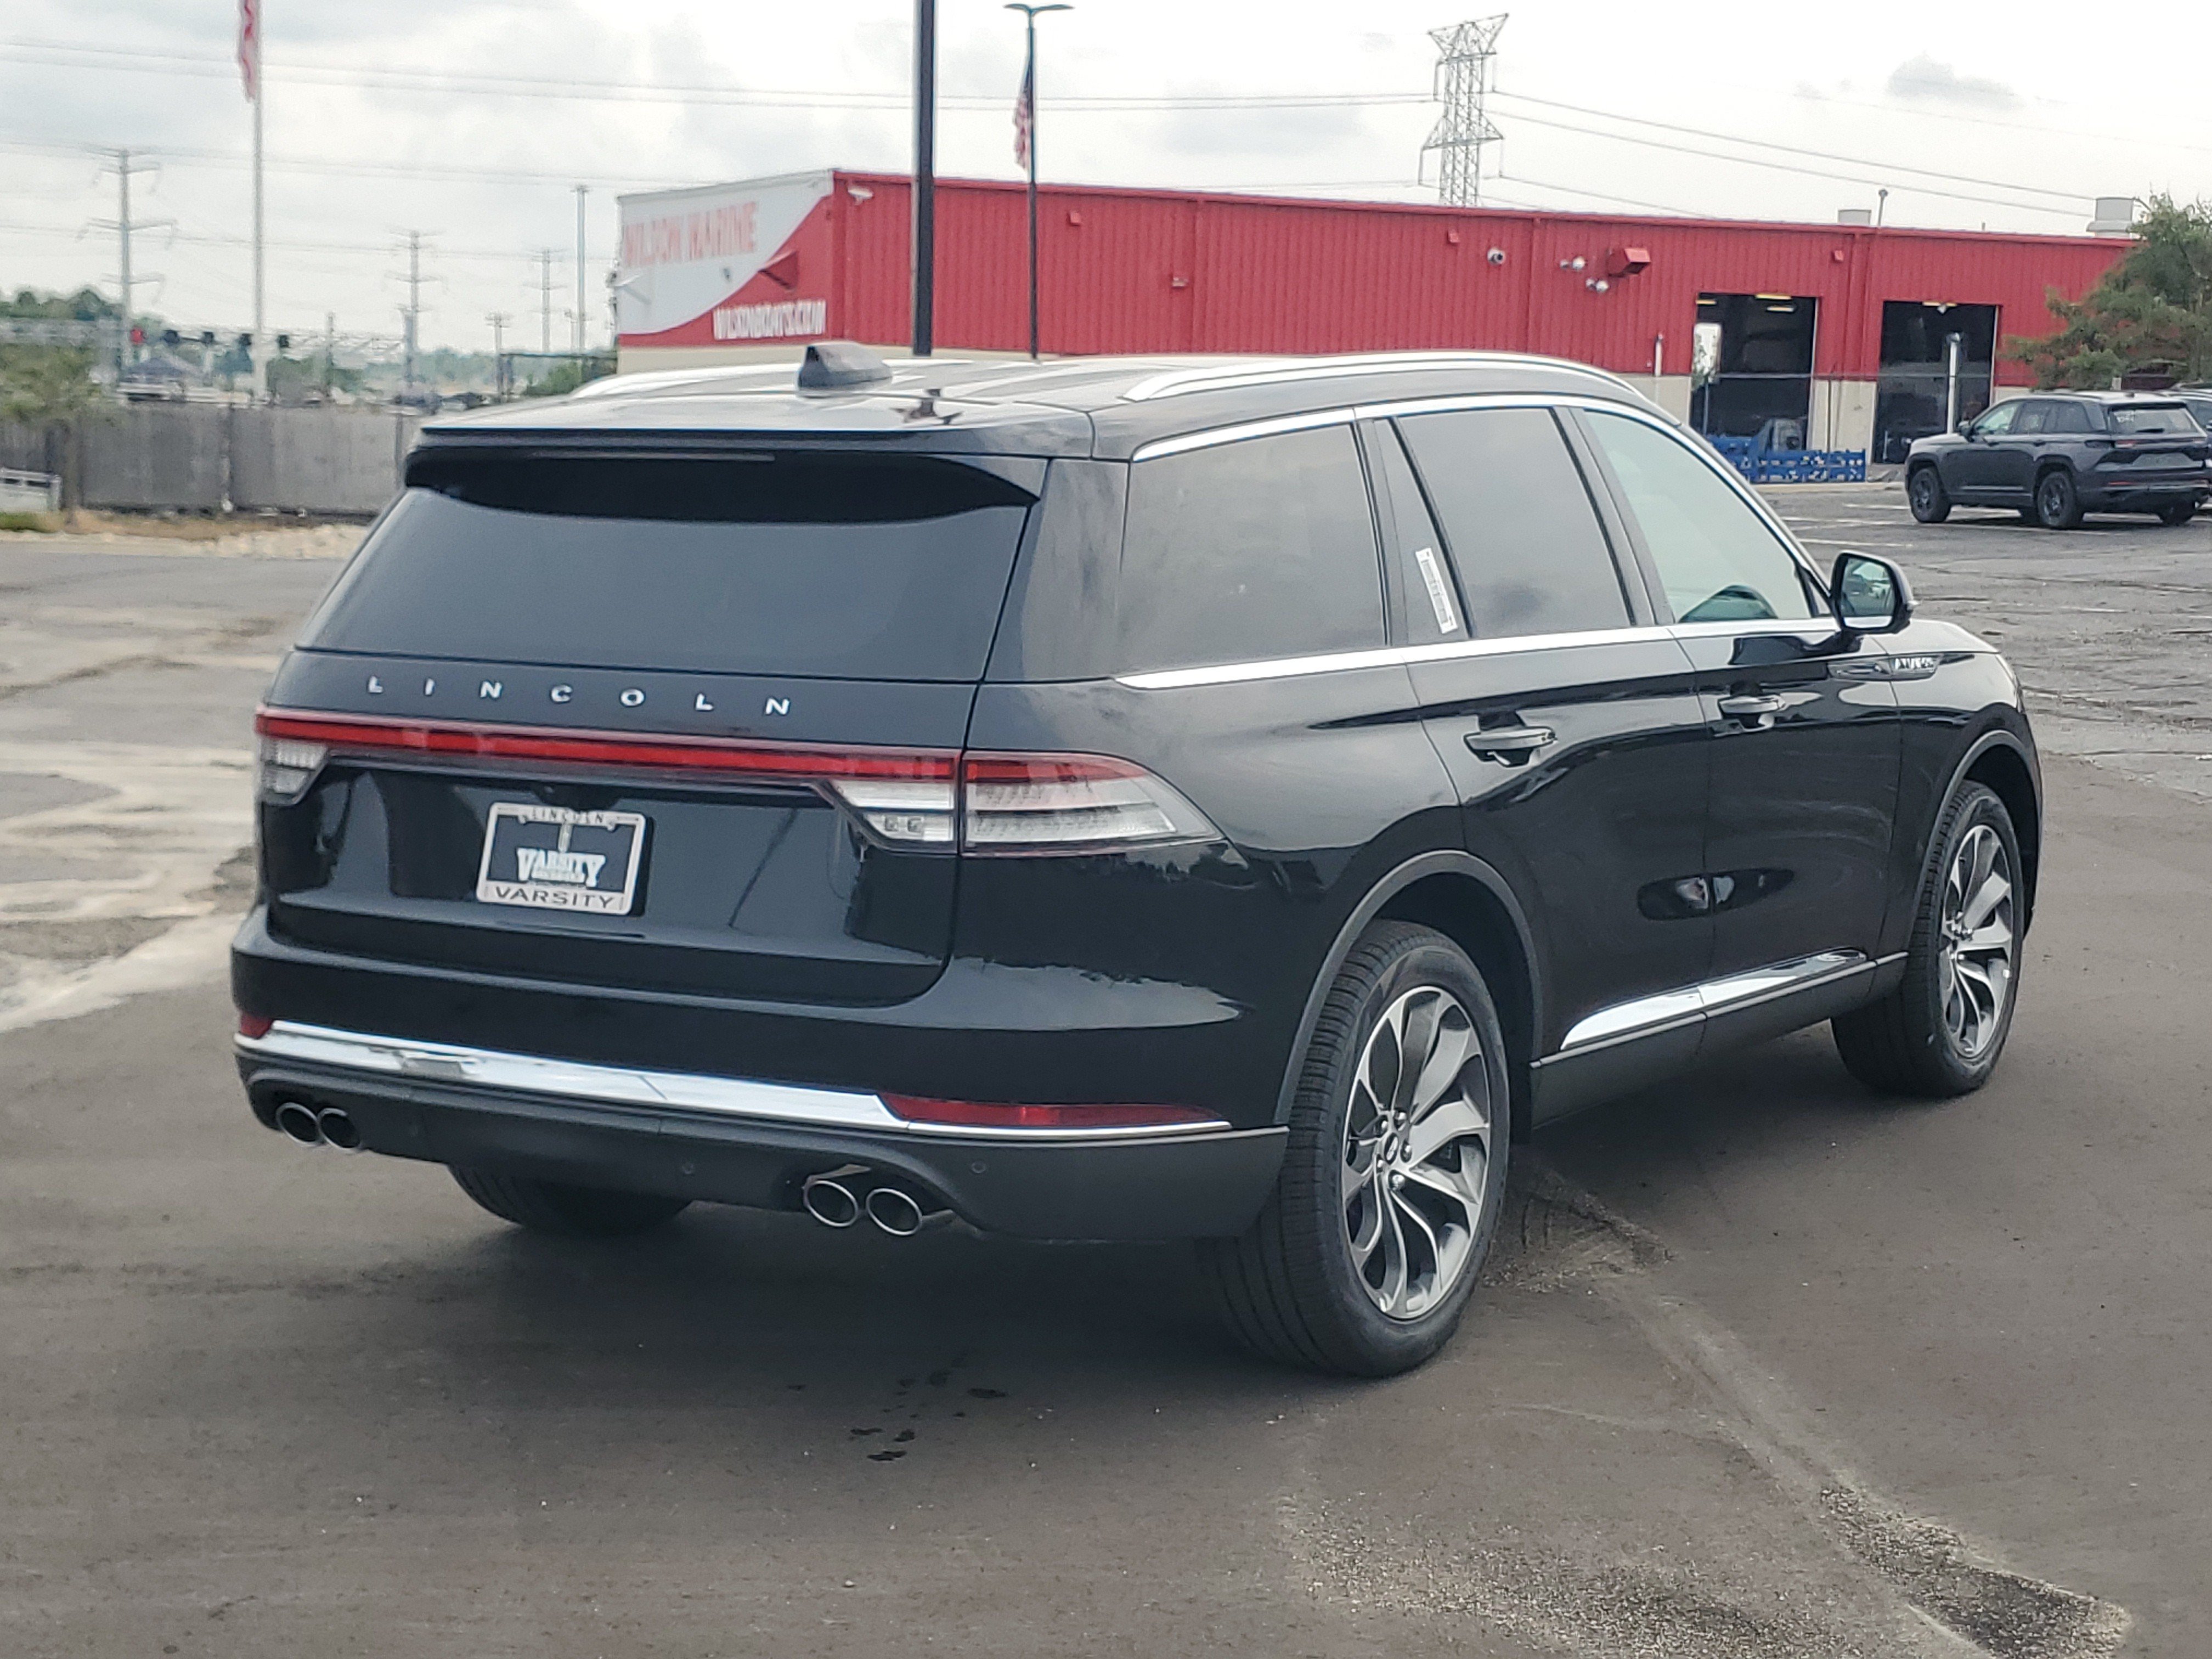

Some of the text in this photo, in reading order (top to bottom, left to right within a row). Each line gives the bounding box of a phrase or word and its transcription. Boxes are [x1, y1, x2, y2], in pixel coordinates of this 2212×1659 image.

[689, 201, 757, 261] MARINE
[366, 675, 792, 716] LINCOLN
[495, 885, 615, 909] VARSITY
